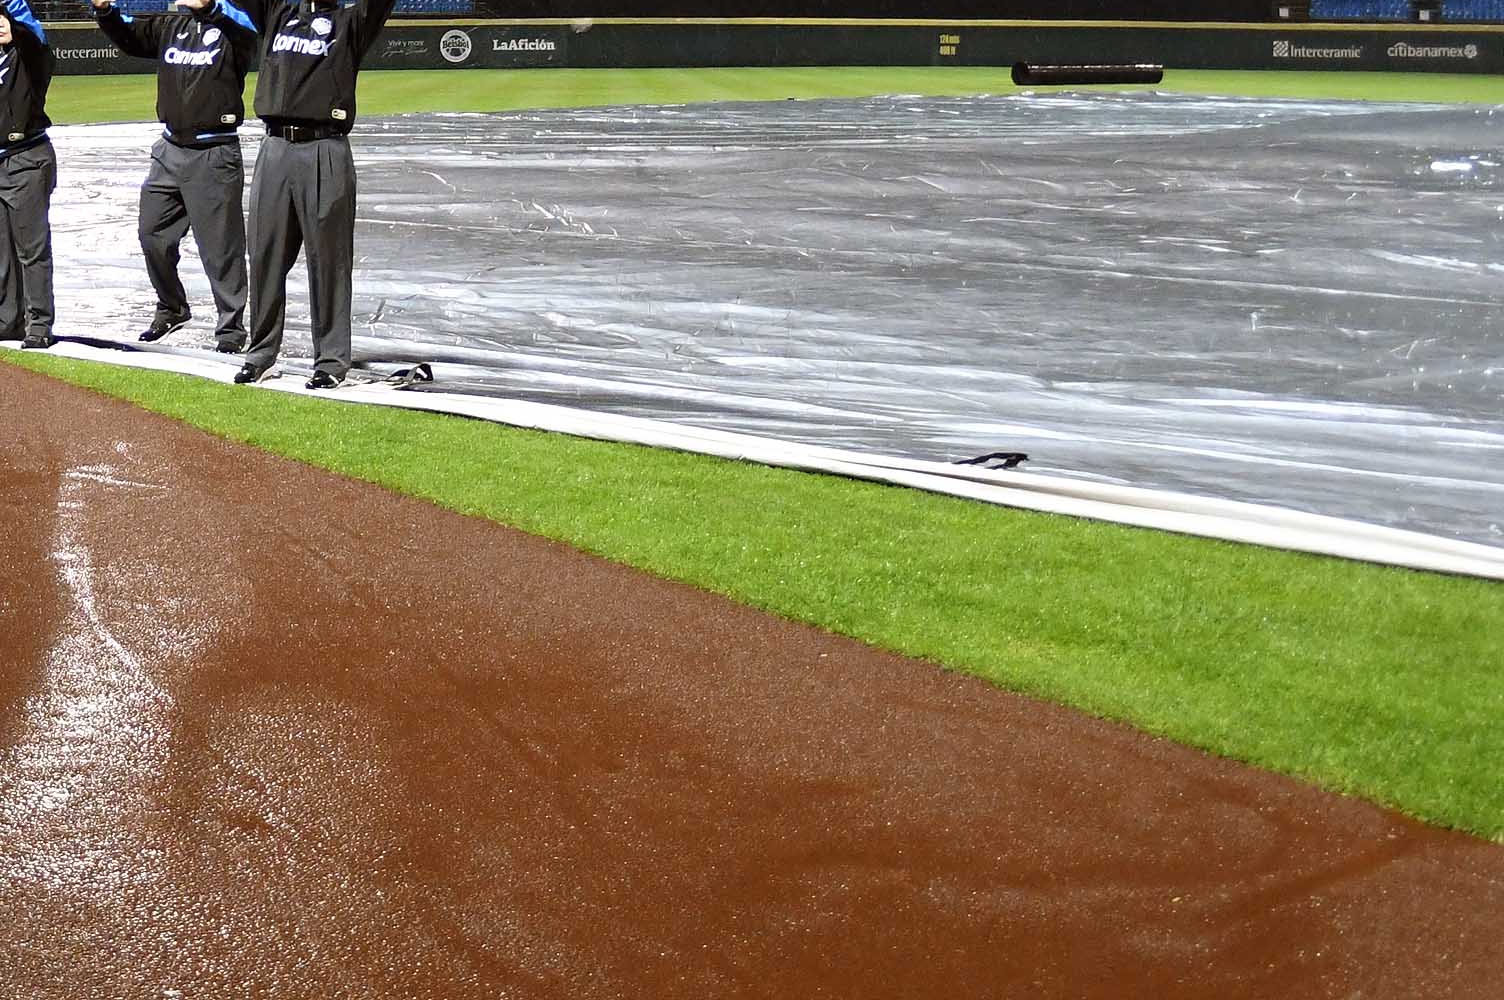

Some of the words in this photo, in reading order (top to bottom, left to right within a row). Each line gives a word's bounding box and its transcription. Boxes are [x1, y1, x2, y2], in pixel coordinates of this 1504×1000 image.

[53, 45, 119, 59] terceramic
[1290, 45, 1360, 58] Interceramic
[1386, 42, 1463, 57] citibanamex
